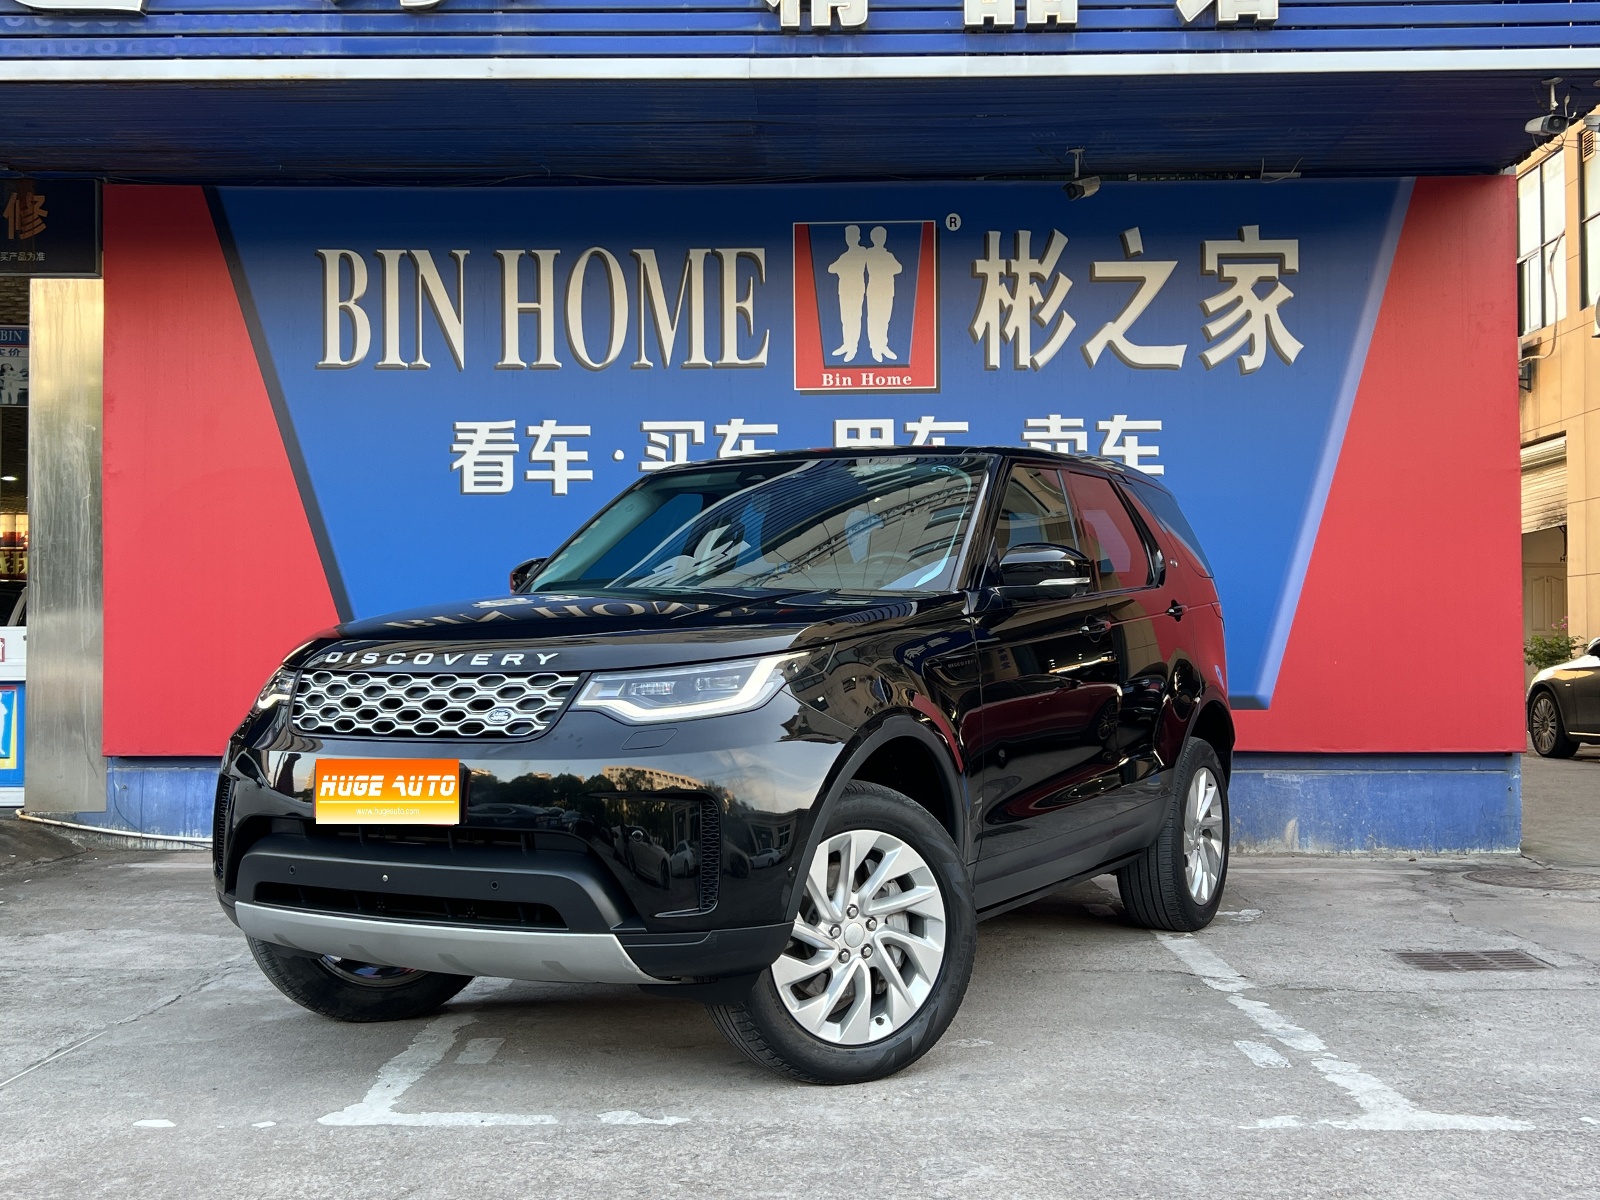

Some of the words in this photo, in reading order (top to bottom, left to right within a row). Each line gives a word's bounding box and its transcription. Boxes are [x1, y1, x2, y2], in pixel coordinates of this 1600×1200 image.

[3, 192, 49, 240] 修
[315, 247, 471, 372] BIN
[494, 246, 770, 372] HOME
[968, 224, 1304, 375] 彬之家
[1, 330, 23, 341] BIN
[822, 373, 852, 387] Bin
[861, 372, 912, 386] Home
[324, 651, 559, 666] DISCOVERY
